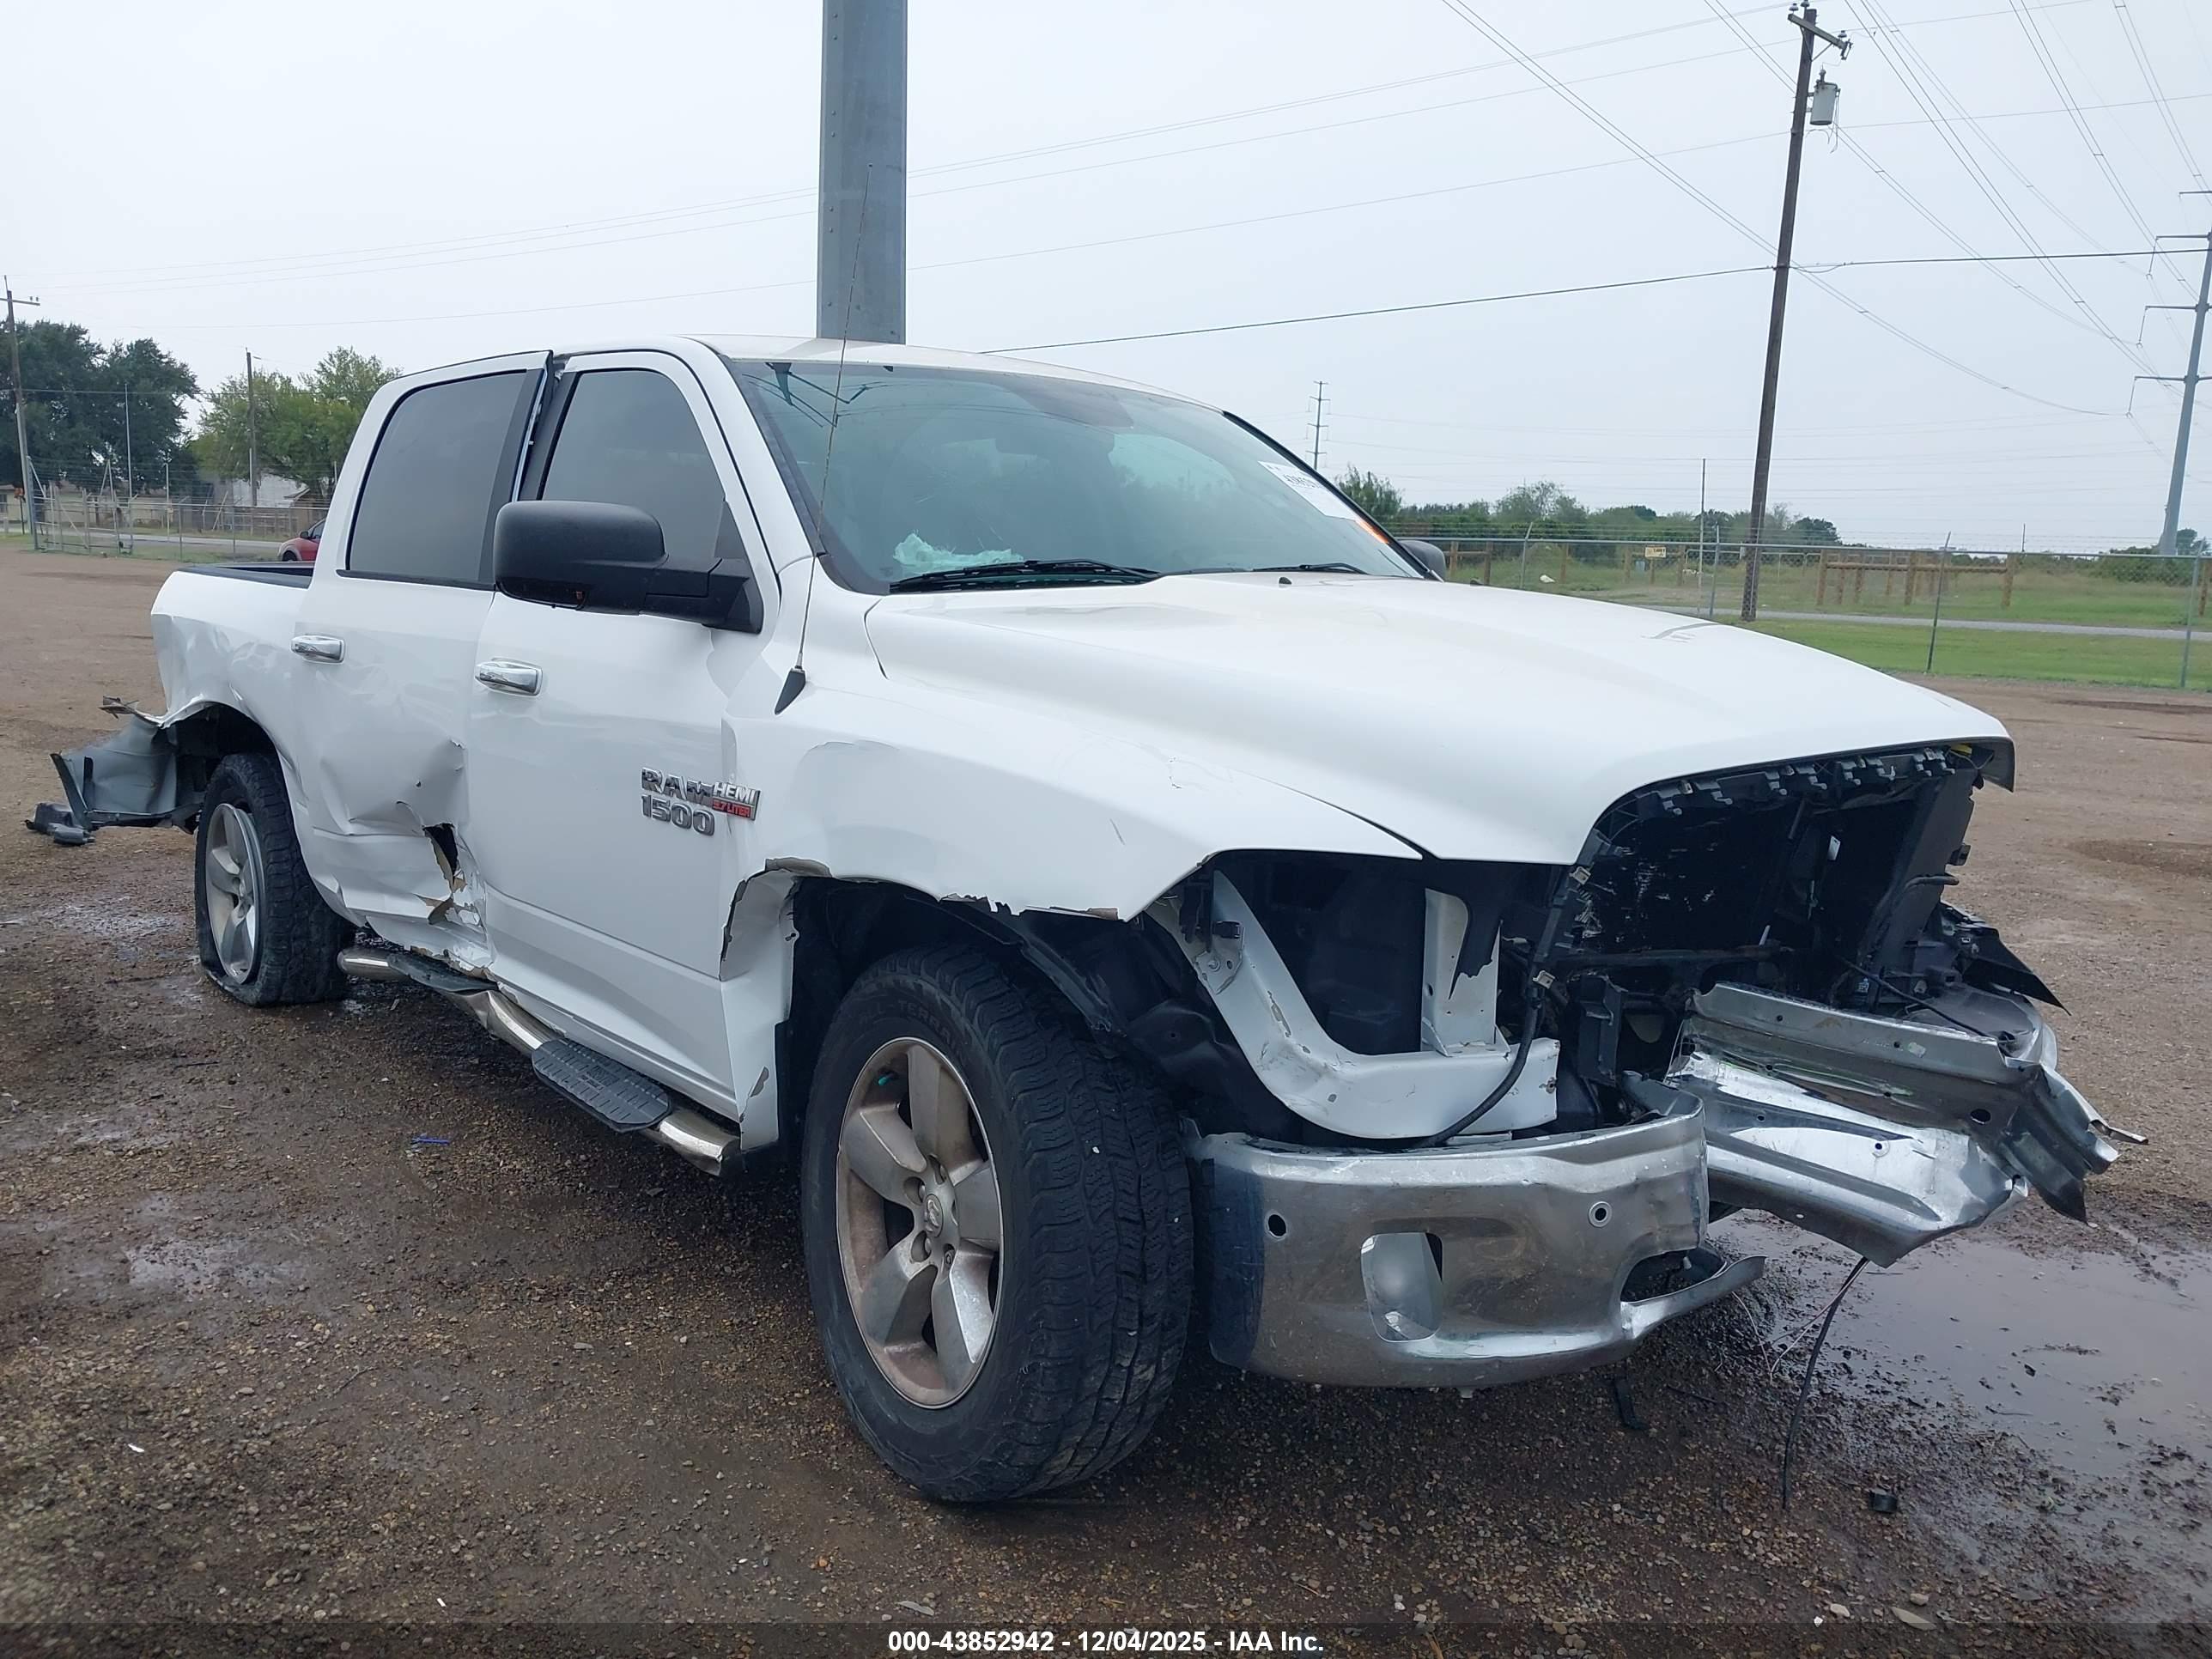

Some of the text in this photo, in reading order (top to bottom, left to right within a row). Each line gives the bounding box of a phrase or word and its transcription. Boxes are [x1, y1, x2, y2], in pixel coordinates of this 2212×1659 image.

[641, 767, 714, 808] RAM
[714, 781, 757, 805] HEMI
[641, 793, 715, 836] 1500
